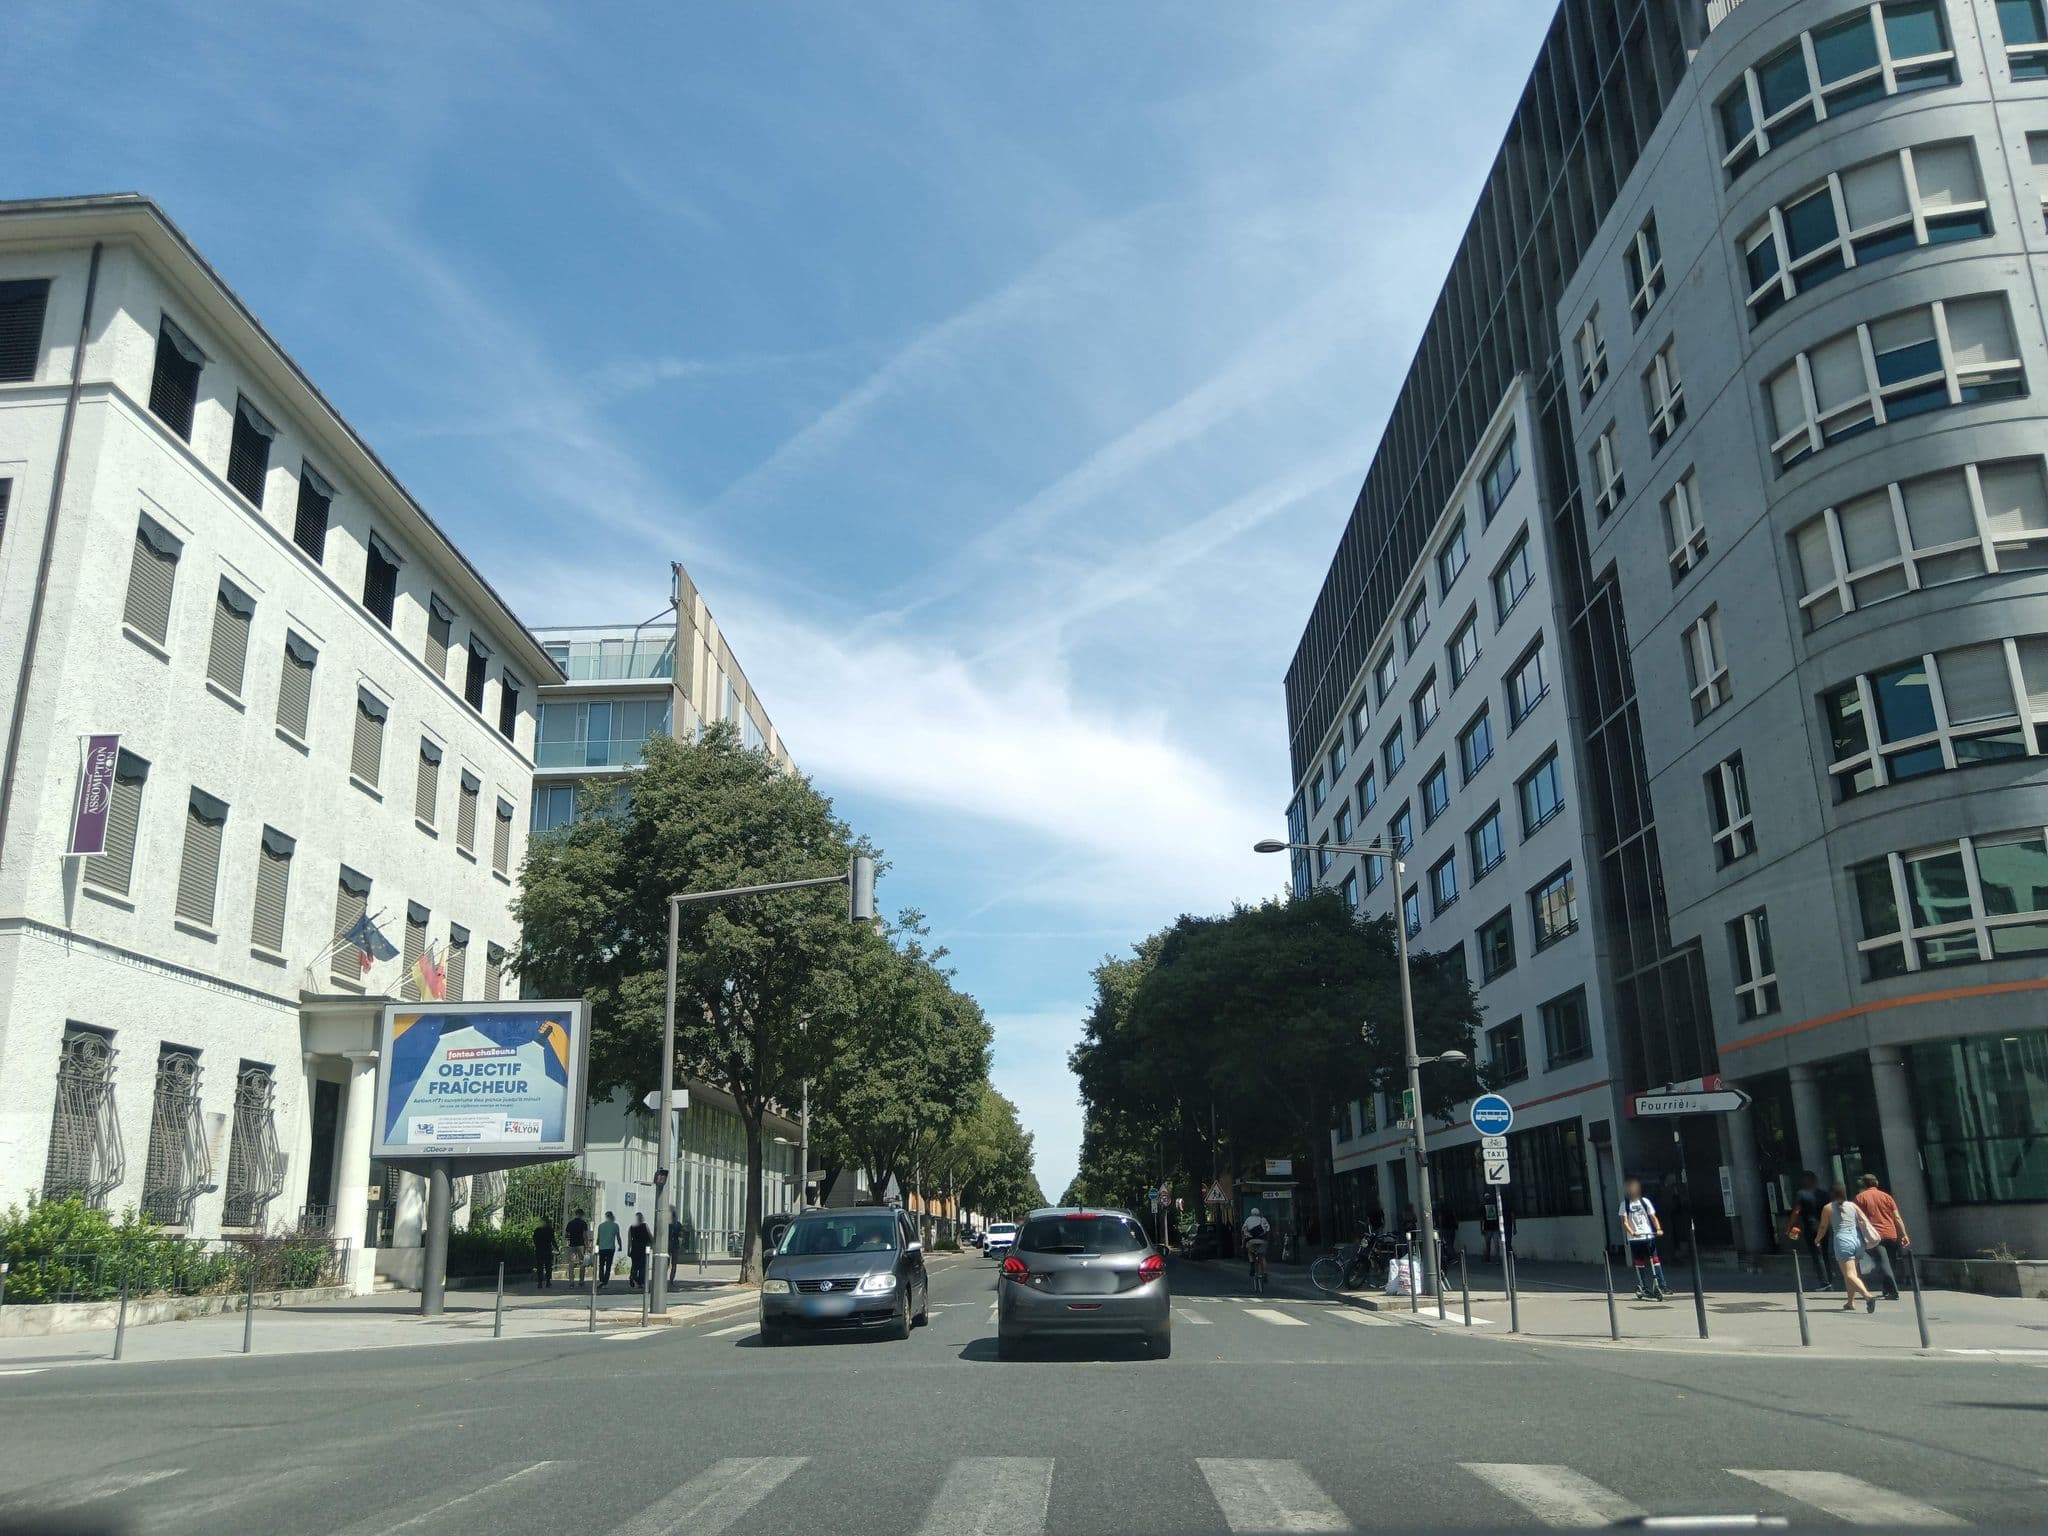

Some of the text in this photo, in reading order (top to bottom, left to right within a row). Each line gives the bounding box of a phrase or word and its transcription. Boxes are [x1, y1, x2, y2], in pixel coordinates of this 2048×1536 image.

[88, 746, 107, 814] ASSOMPTION
[439, 1063, 521, 1076] OBJECTIF
[429, 1078, 528, 1094] FRAÎCHEUR
[1641, 1100, 1698, 1112] Fourrièr
[518, 1126, 539, 1134] LYON
